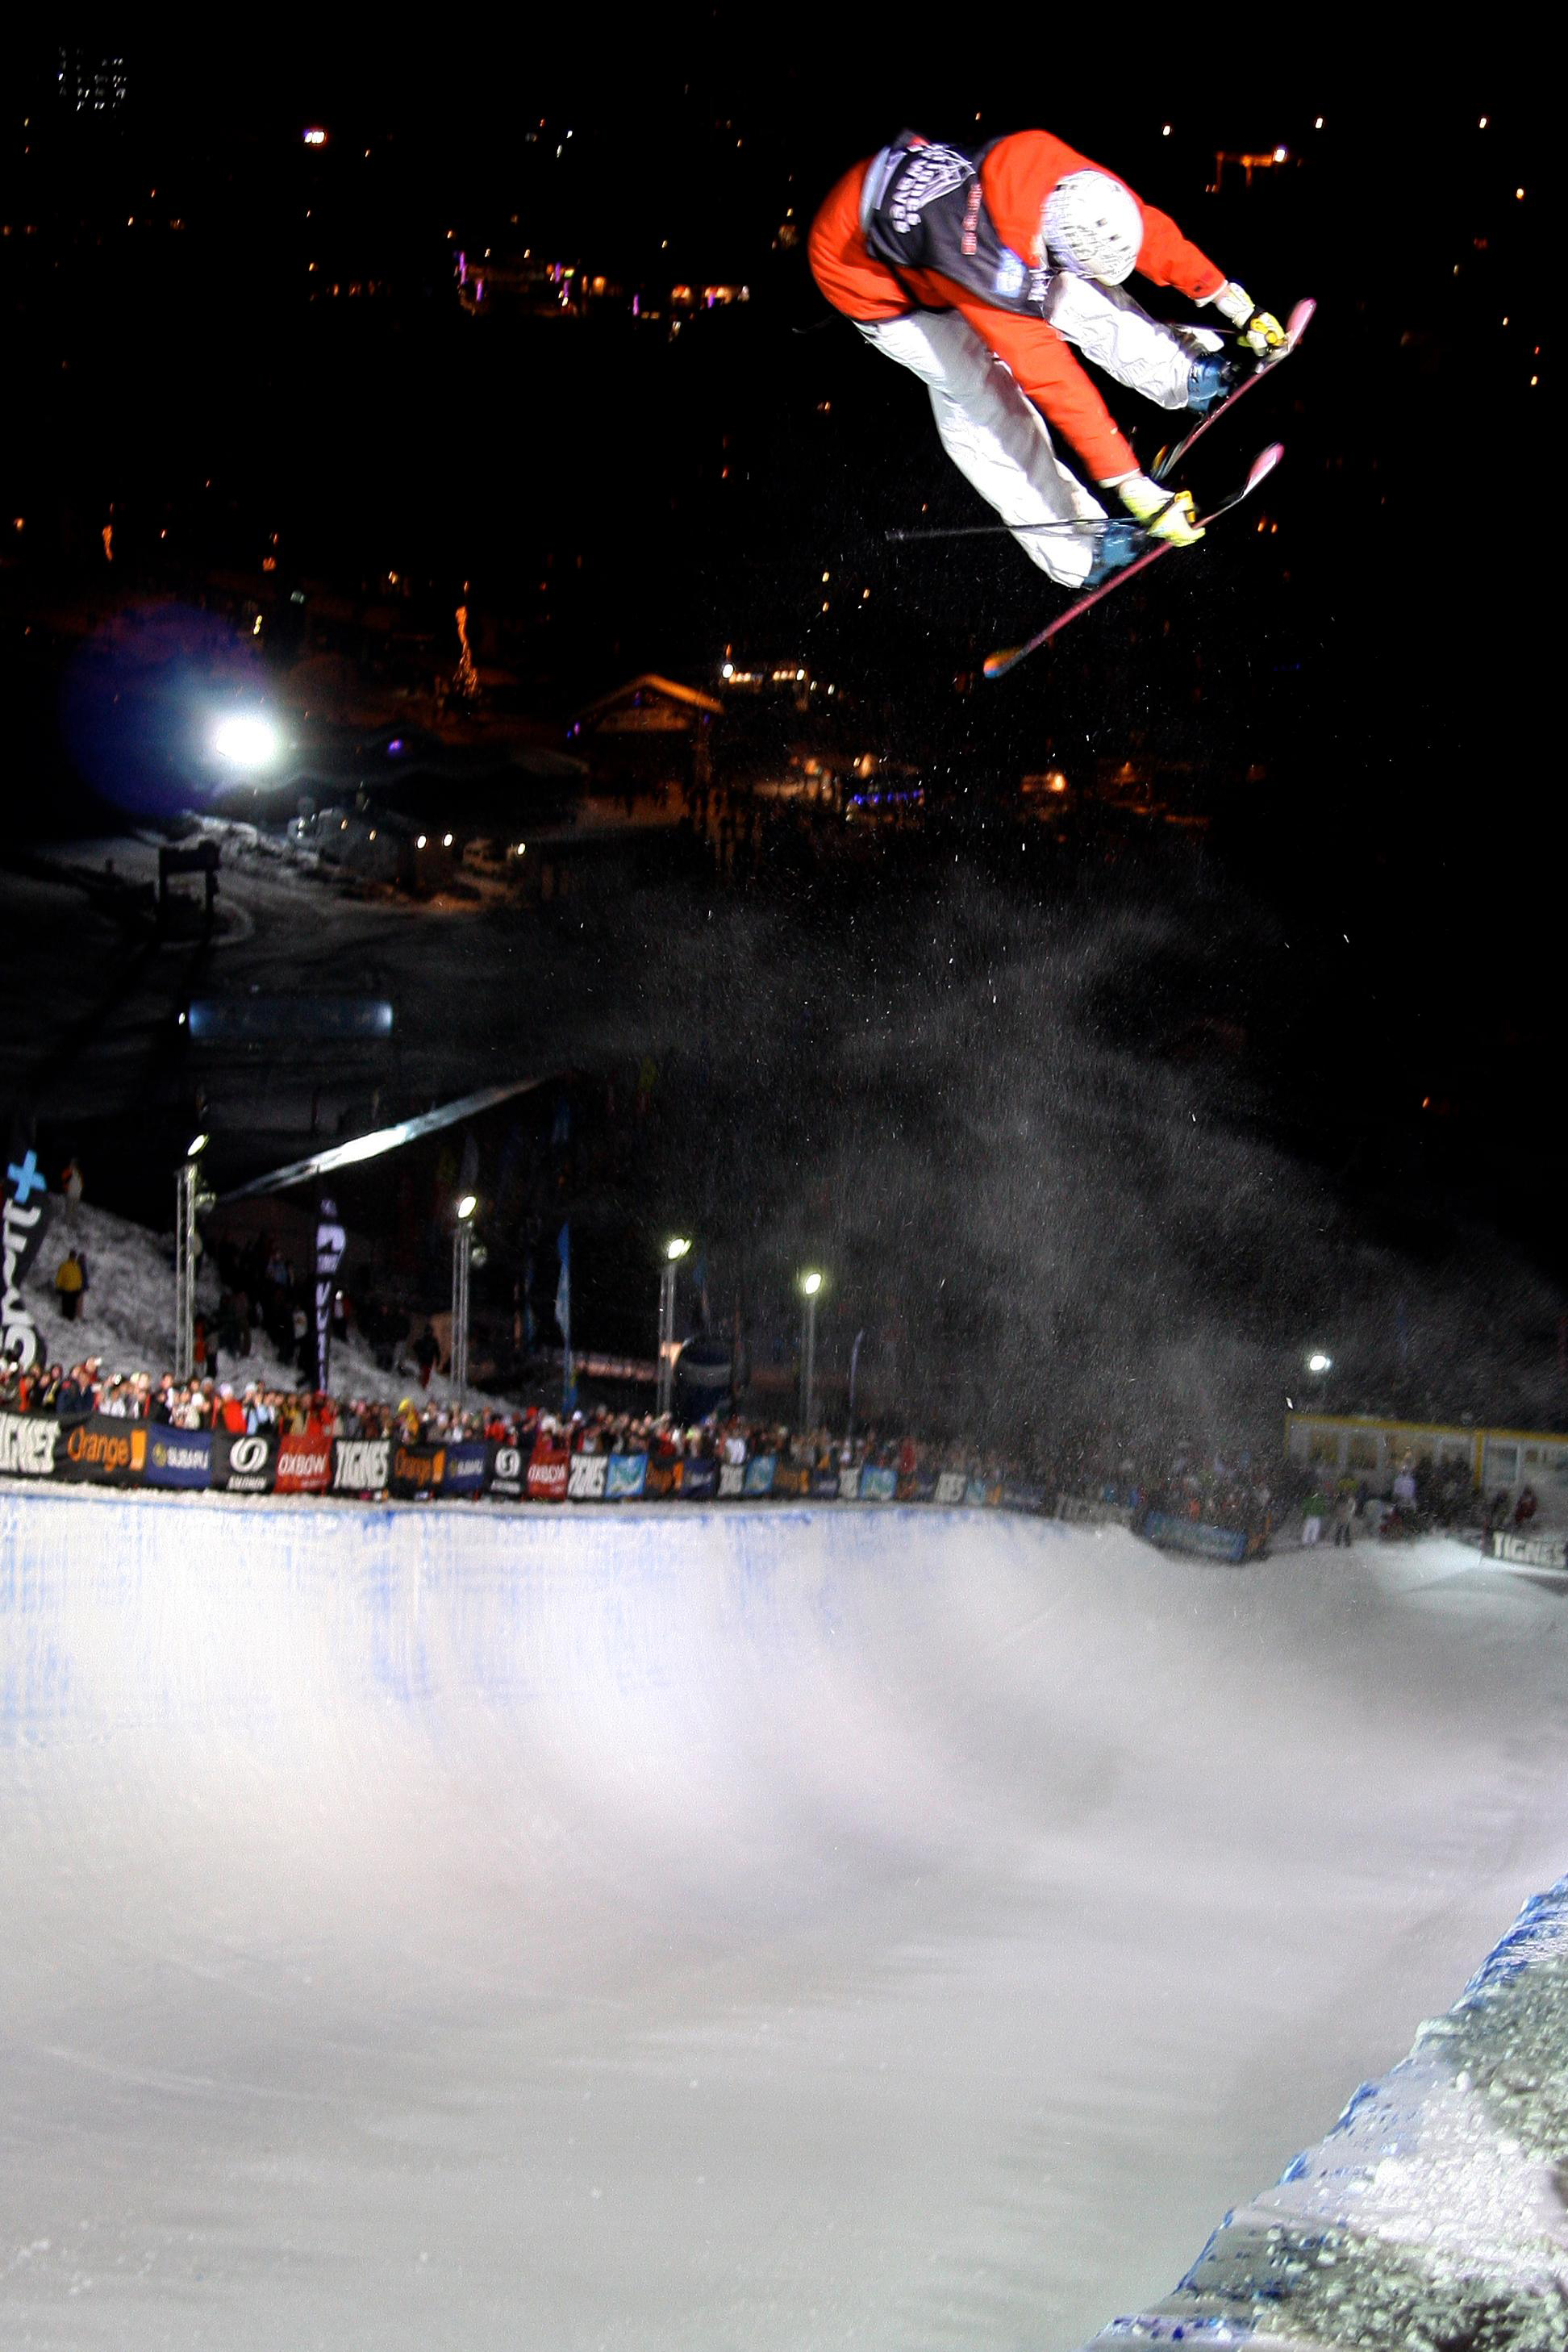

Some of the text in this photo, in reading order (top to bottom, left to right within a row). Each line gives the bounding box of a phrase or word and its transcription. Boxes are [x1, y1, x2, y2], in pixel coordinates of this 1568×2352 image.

[0, 1412, 60, 1474] IGNES
[67, 1425, 131, 1472] Orange
[277, 1453, 327, 1478] OXBOW
[332, 1440, 390, 1489] TIGNES
